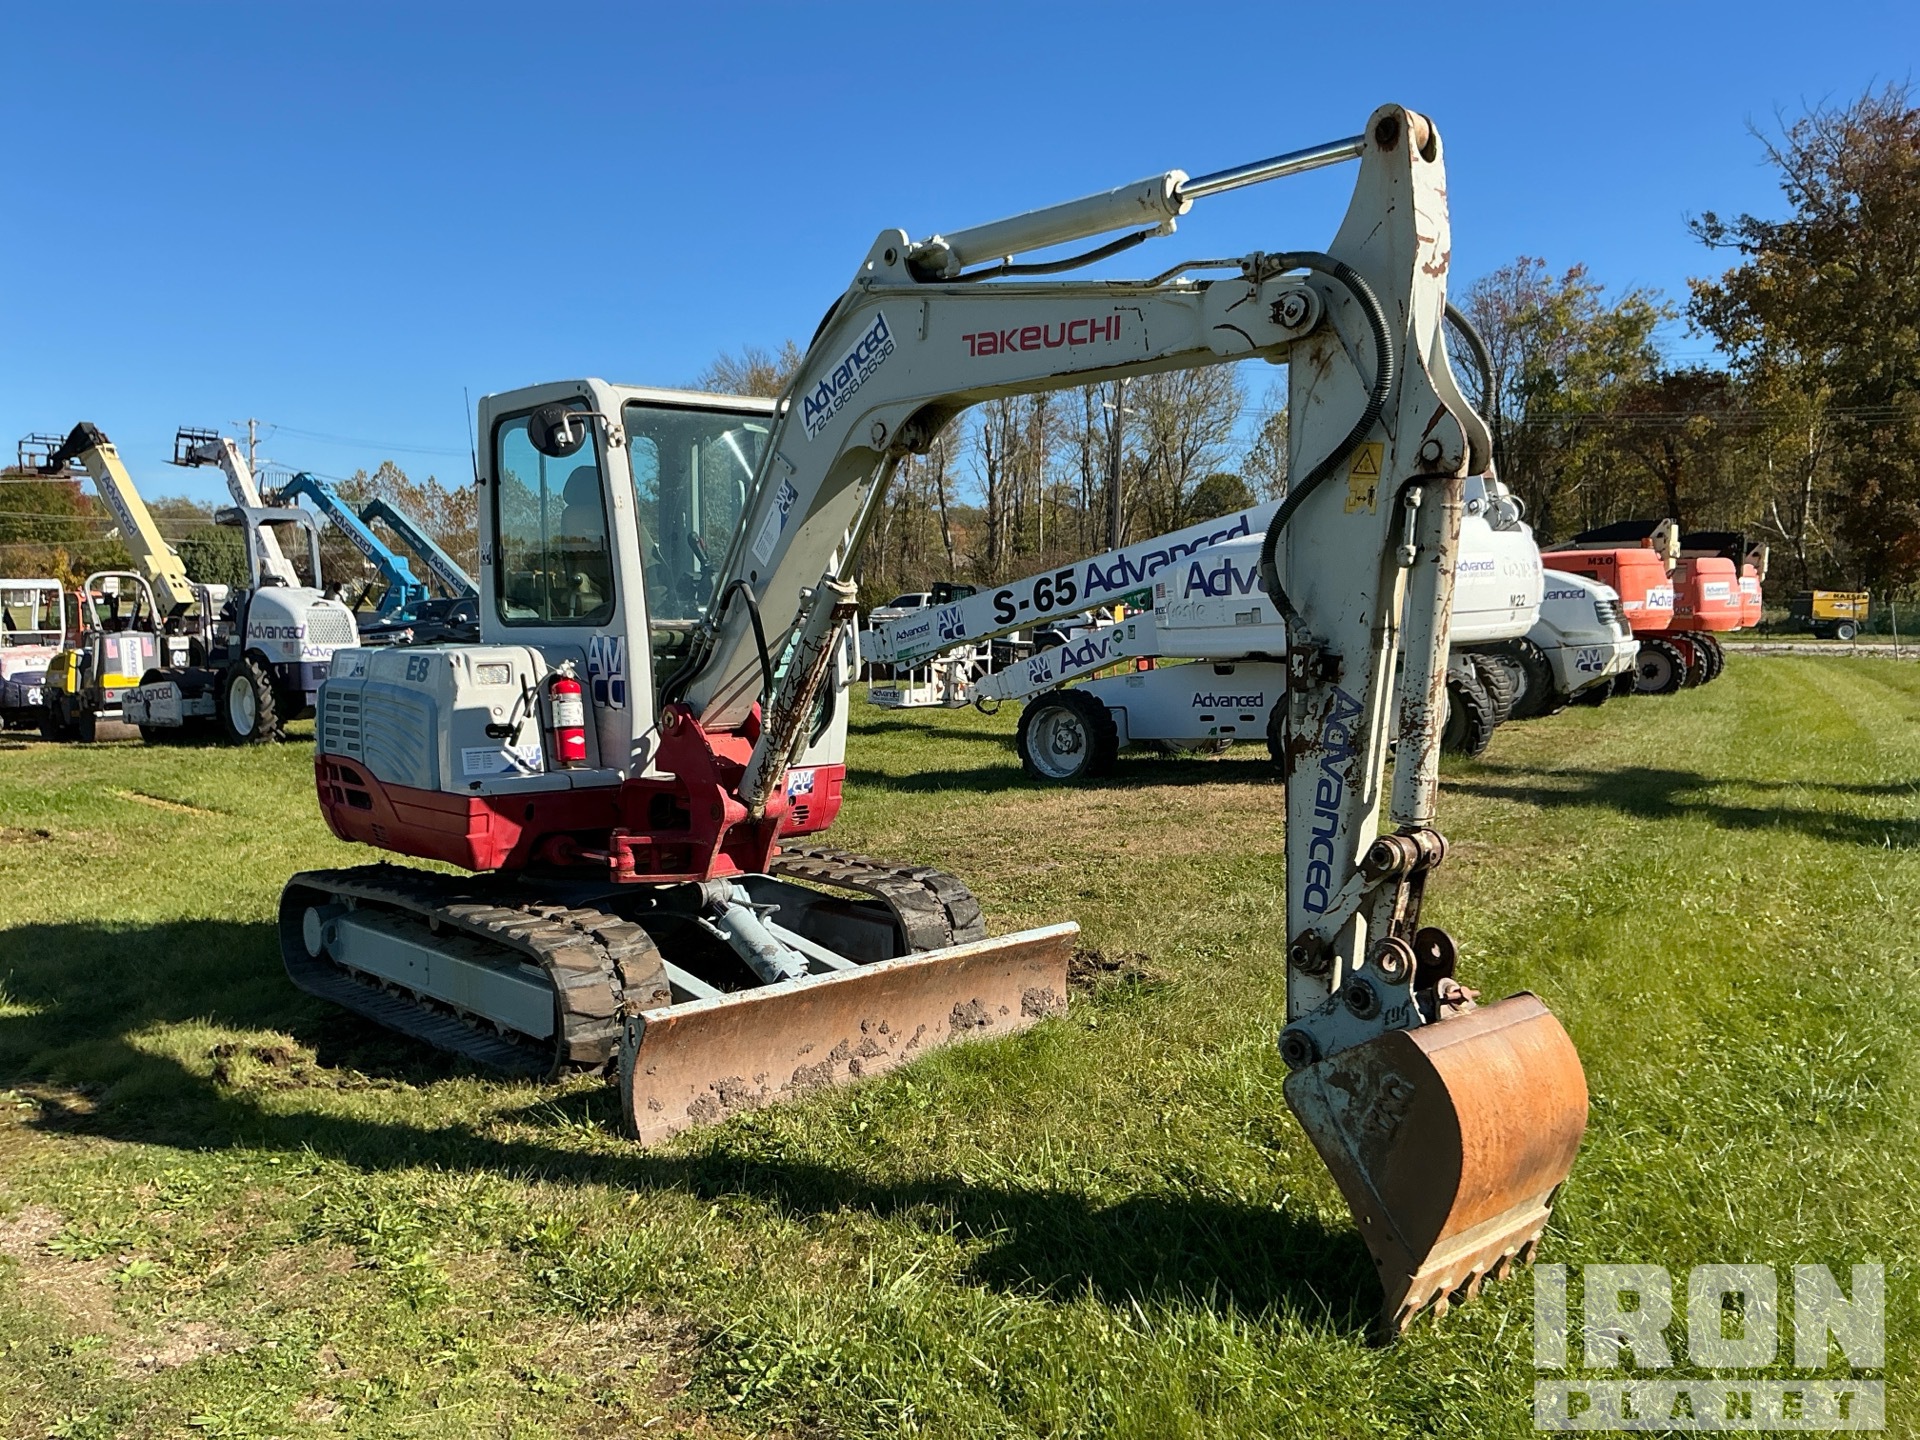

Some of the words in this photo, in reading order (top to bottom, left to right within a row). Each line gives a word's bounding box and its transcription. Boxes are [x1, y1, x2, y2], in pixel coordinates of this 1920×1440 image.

[962, 315, 1121, 357] TAKEUCHI
[803, 312, 890, 427] Advanced
[808, 339, 895, 438] 724.966.2636
[102, 476, 137, 536] Advanced
[329, 508, 373, 553] Advanced
[431, 555, 466, 592] Advanced
[993, 568, 1078, 625] S-65
[1084, 514, 1251, 599] Advand
[1455, 560, 1495, 572] Advanced
[1587, 557, 1614, 565] M10
[1510, 594, 1526, 607] M22
[938, 604, 962, 629] AM
[248, 622, 306, 640] Advanced
[896, 622, 930, 641] Advanced
[406, 655, 430, 682] E8
[1575, 650, 1602, 664] AM
[1191, 692, 1264, 708] Advanced
[1303, 685, 1364, 915] Advanced
